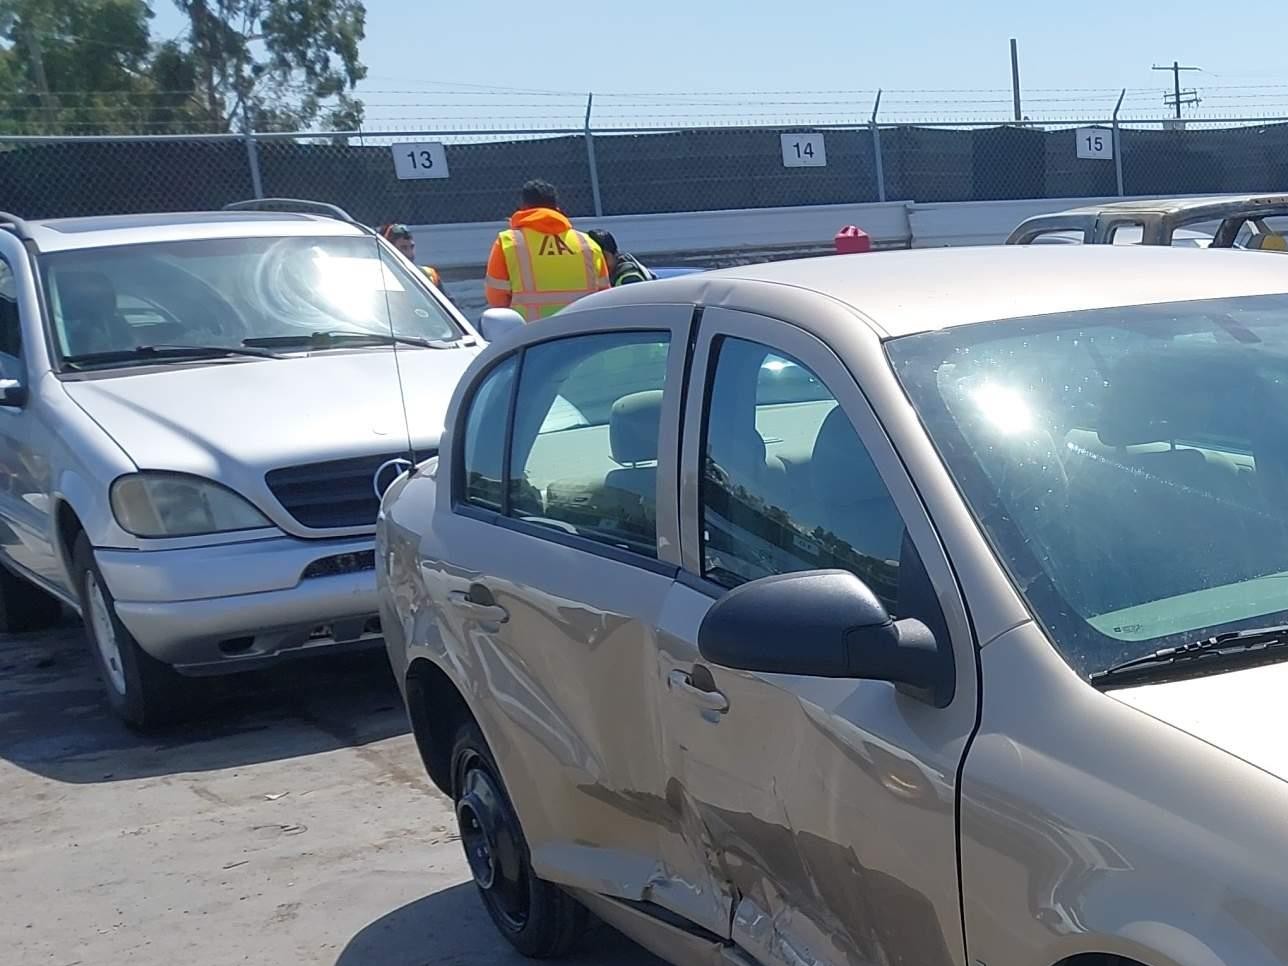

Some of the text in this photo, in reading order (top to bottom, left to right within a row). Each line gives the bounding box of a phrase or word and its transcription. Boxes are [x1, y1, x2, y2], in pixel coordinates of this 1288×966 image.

[793, 142, 815, 158] 14
[1086, 136, 1103, 151] 15
[408, 151, 433, 169] 13
